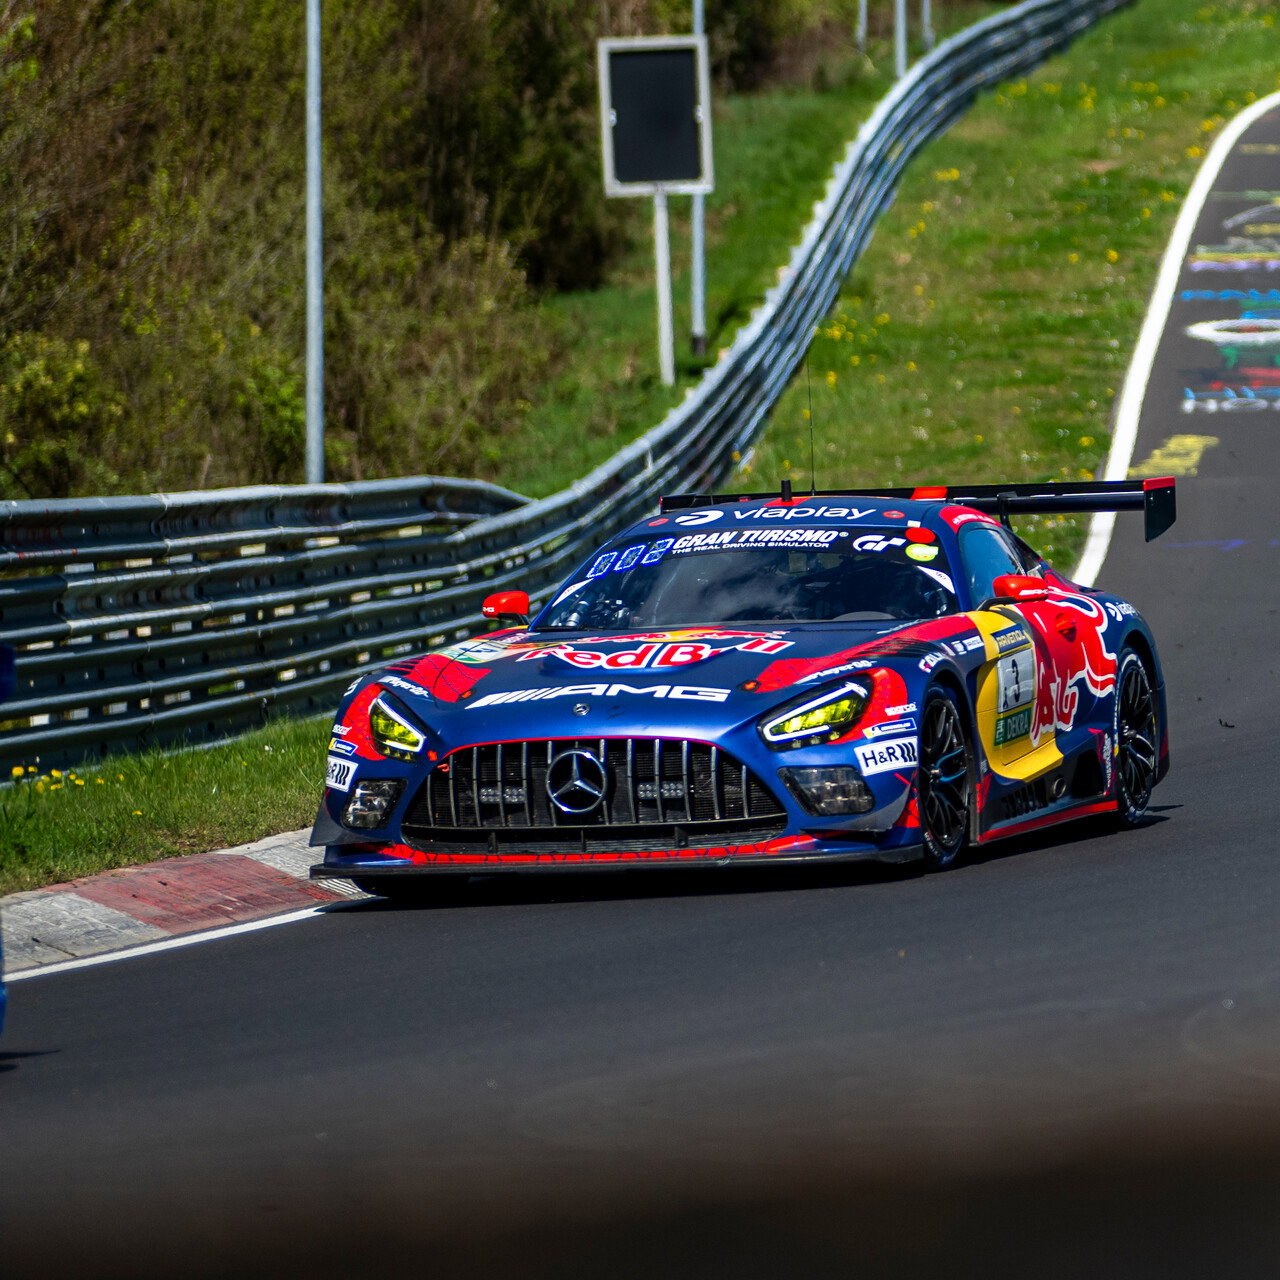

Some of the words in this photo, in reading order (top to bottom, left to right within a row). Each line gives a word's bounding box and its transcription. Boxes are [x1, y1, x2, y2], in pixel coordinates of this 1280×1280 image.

[733, 505, 877, 520] viaplay
[673, 530, 739, 550] GRAN
[692, 544, 721, 552] REAL
[766, 541, 831, 549] SIMULATOR
[862, 746, 900, 768] H&R
